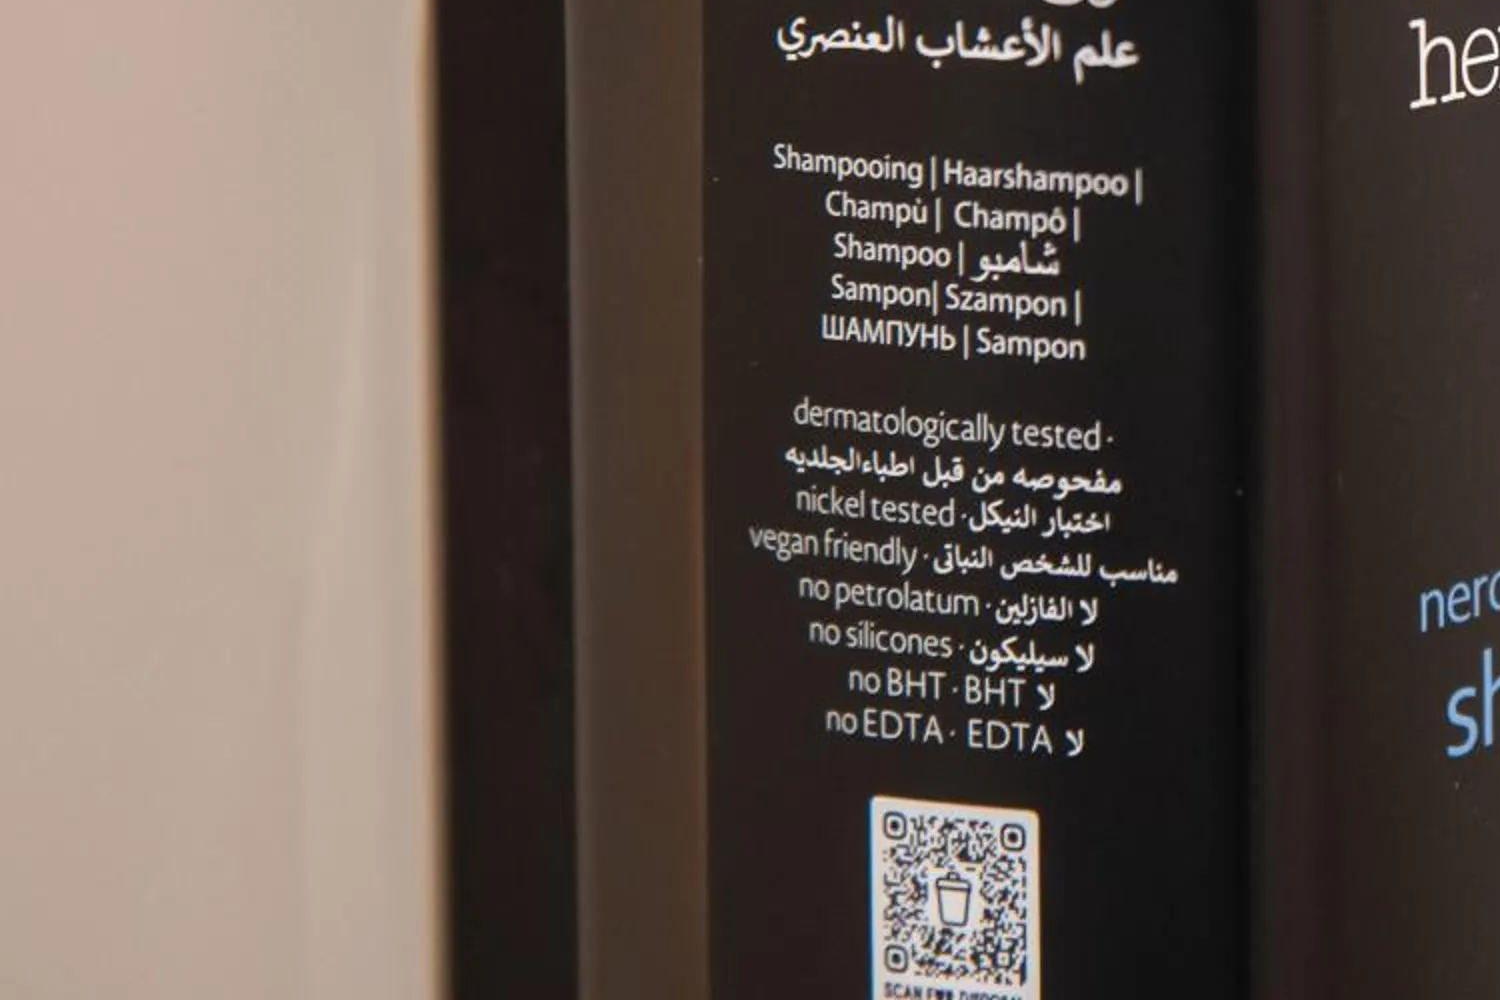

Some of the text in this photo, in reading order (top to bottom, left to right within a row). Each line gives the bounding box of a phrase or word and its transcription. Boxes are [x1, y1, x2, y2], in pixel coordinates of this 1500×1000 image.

[776, 14, 1140, 85] علم الأعشاب العنصري
[773, 143, 923, 188] Shampooing
[943, 158, 1129, 199] Haarshampoo
[833, 231, 951, 271] Shampoo
[969, 239, 1061, 282] شامبو
[945, 283, 1067, 321] Szampon
[975, 327, 1087, 364] Sampon
[793, 396, 1101, 452] dermatologically tested
[922, 456, 965, 488] قبل
[971, 465, 1005, 493] من
[796, 485, 955, 527] nickel tested
[1040, 505, 1111, 538] اختبار
[748, 525, 918, 576] vegan friendly
[1099, 557, 1179, 588] مناسب
[799, 577, 980, 617] no petrolatum
[1079, 597, 1099, 627] لا
[808, 619, 953, 659] no silicones
[968, 635, 1095, 673] لا سيليكون
[849, 666, 1027, 708] no BHT BHT
[1036, 681, 1056, 711] لا
[826, 707, 1053, 755] no EDTA EDTA
[1064, 728, 1085, 757] لا
